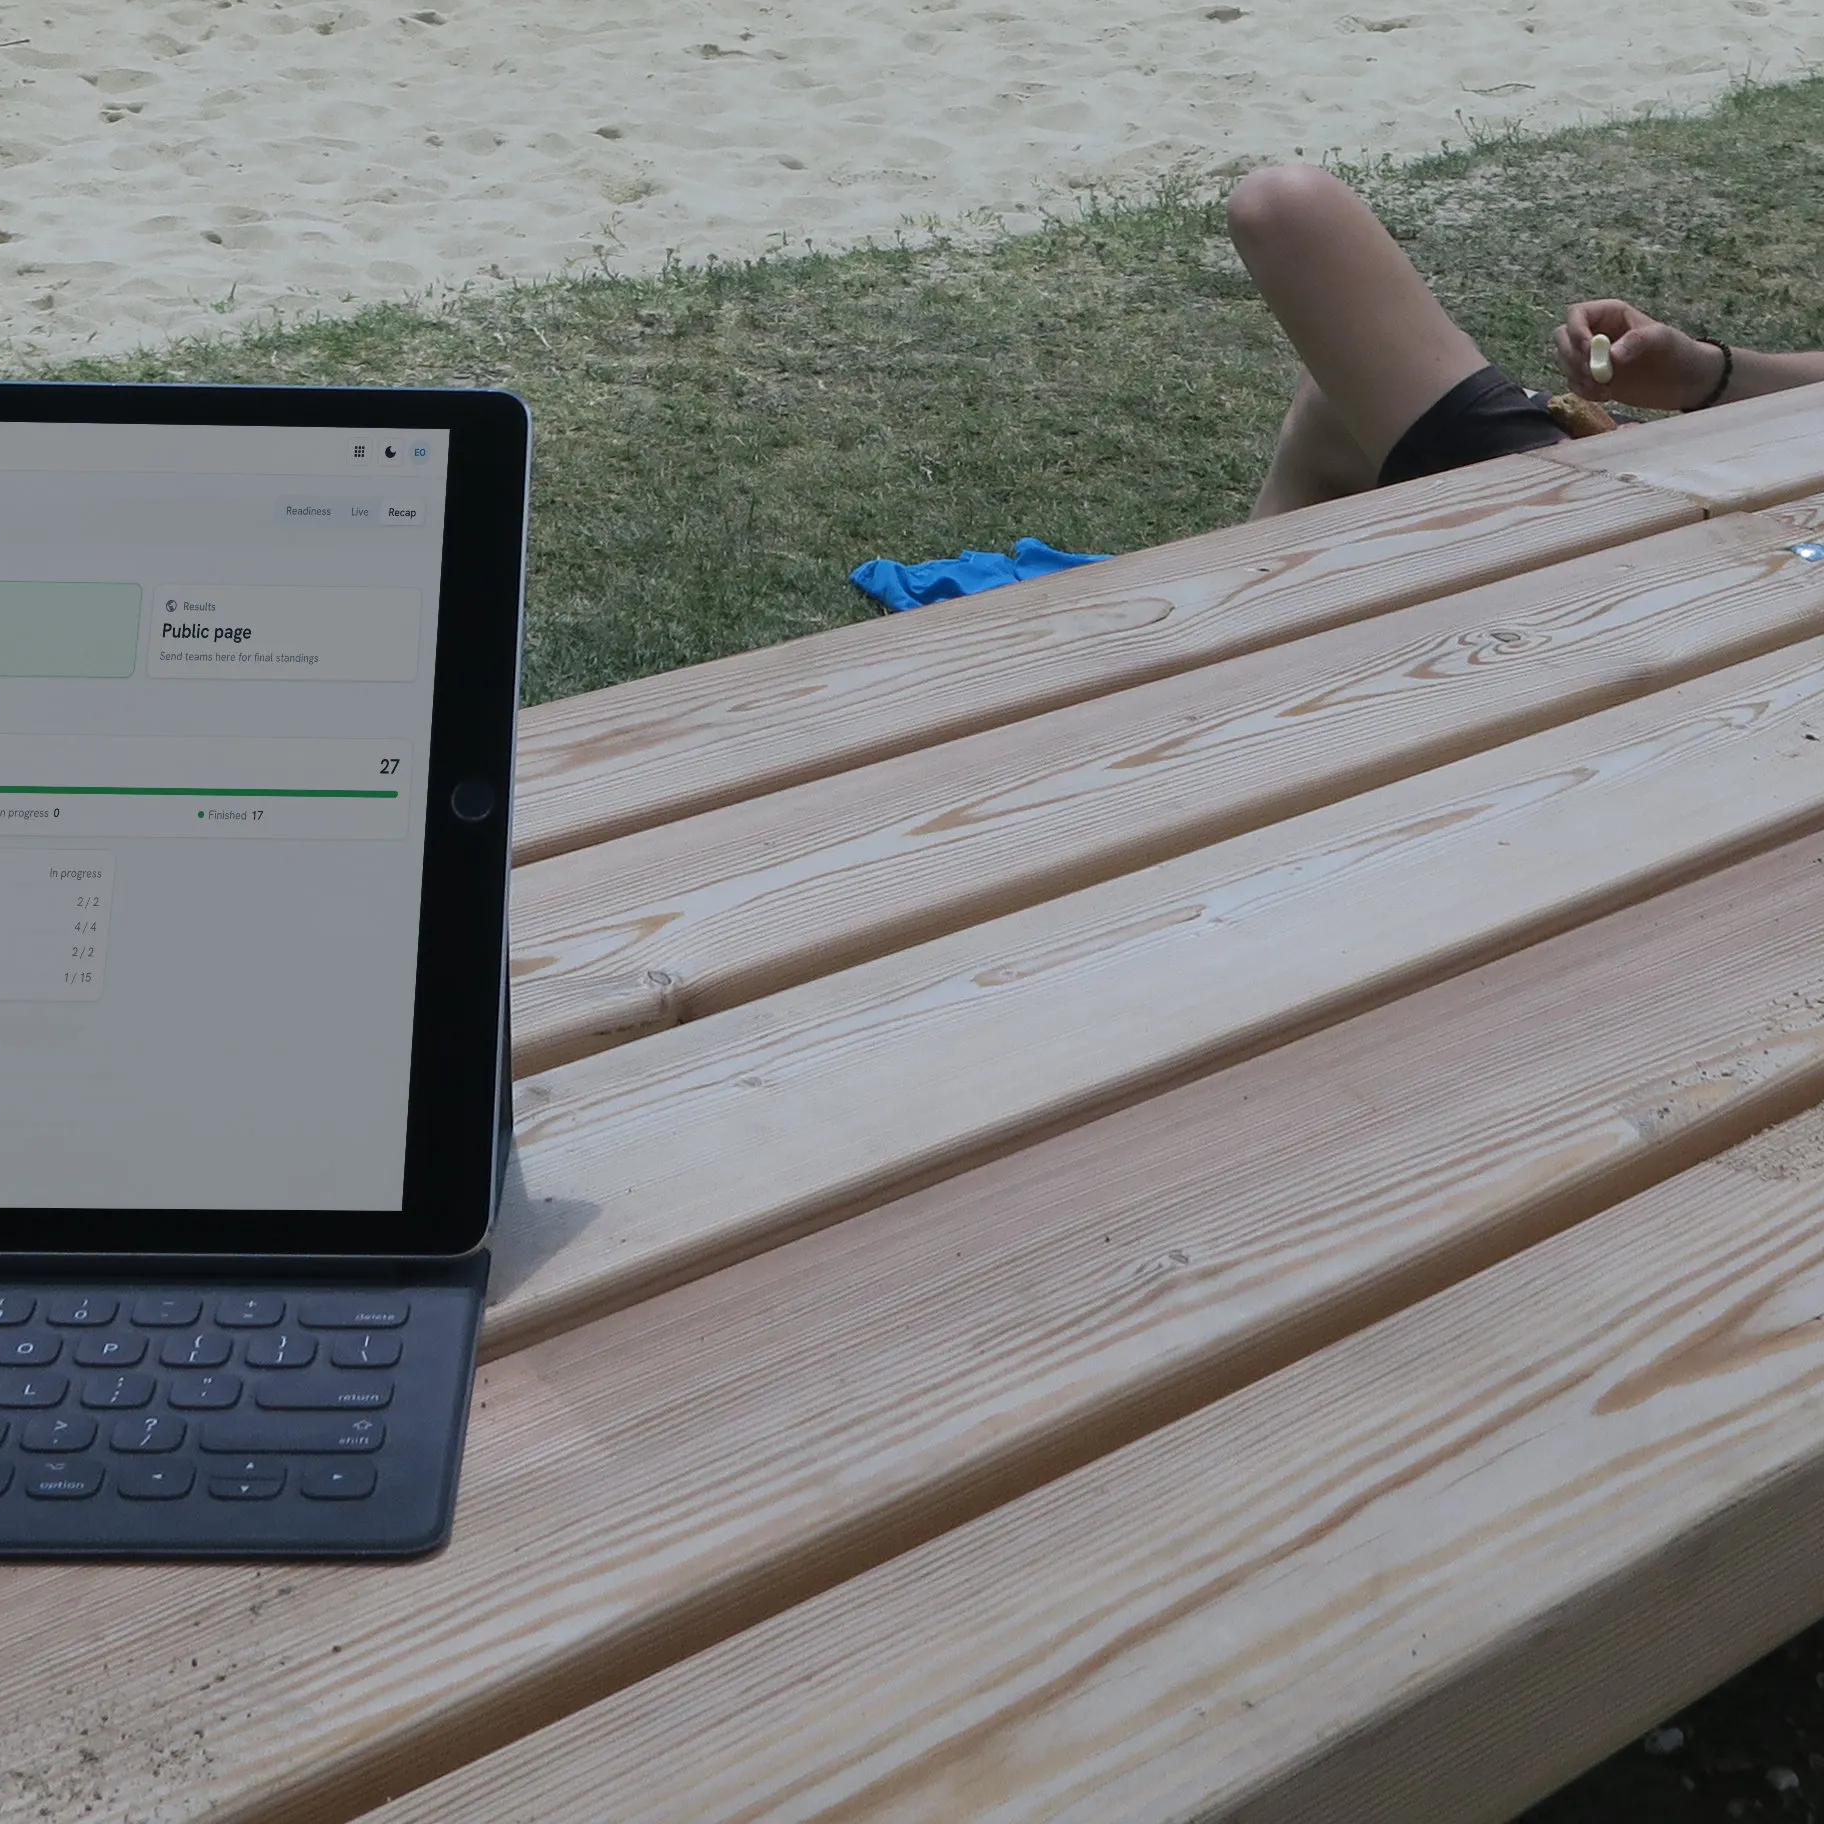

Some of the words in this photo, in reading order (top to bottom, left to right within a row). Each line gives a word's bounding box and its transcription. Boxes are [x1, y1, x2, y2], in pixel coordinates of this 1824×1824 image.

[413, 447, 427, 457] EO
[285, 505, 332, 516] Readiness
[350, 506, 370, 517] Live
[388, 507, 417, 520] Recap
[182, 601, 217, 612] Results
[162, 622, 210, 639] Public
[213, 627, 252, 644] page
[159, 650, 184, 662] Send
[184, 652, 213, 662] teams
[214, 652, 236, 663] here
[238, 652, 253, 663] for
[253, 652, 274, 663] final
[275, 653, 319, 666] standings
[379, 758, 401, 775] 27
[7, 809, 50, 821] progress
[52, 807, 61, 818] 0
[208, 809, 248, 821] Finished
[251, 809, 264, 821] 17
[49, 867, 59, 878] In
[59, 869, 103, 882] progress
[76, 896, 84, 908] 2
[84, 896, 91, 909] /
[92, 896, 100, 907] 2
[74, 921, 81, 932] 4
[82, 922, 89, 934] /
[89, 921, 97, 932] 4
[71, 946, 79, 958] 2
[79, 946, 86, 960] /
[87, 946, 95, 958] 2
[64, 971, 70, 983] 1
[70, 972, 78, 985] /
[80, 971, 92, 983] 15
[15, 1341, 35, 1355] O
[101, 1342, 120, 1356] P
[23, 1382, 37, 1397] L
